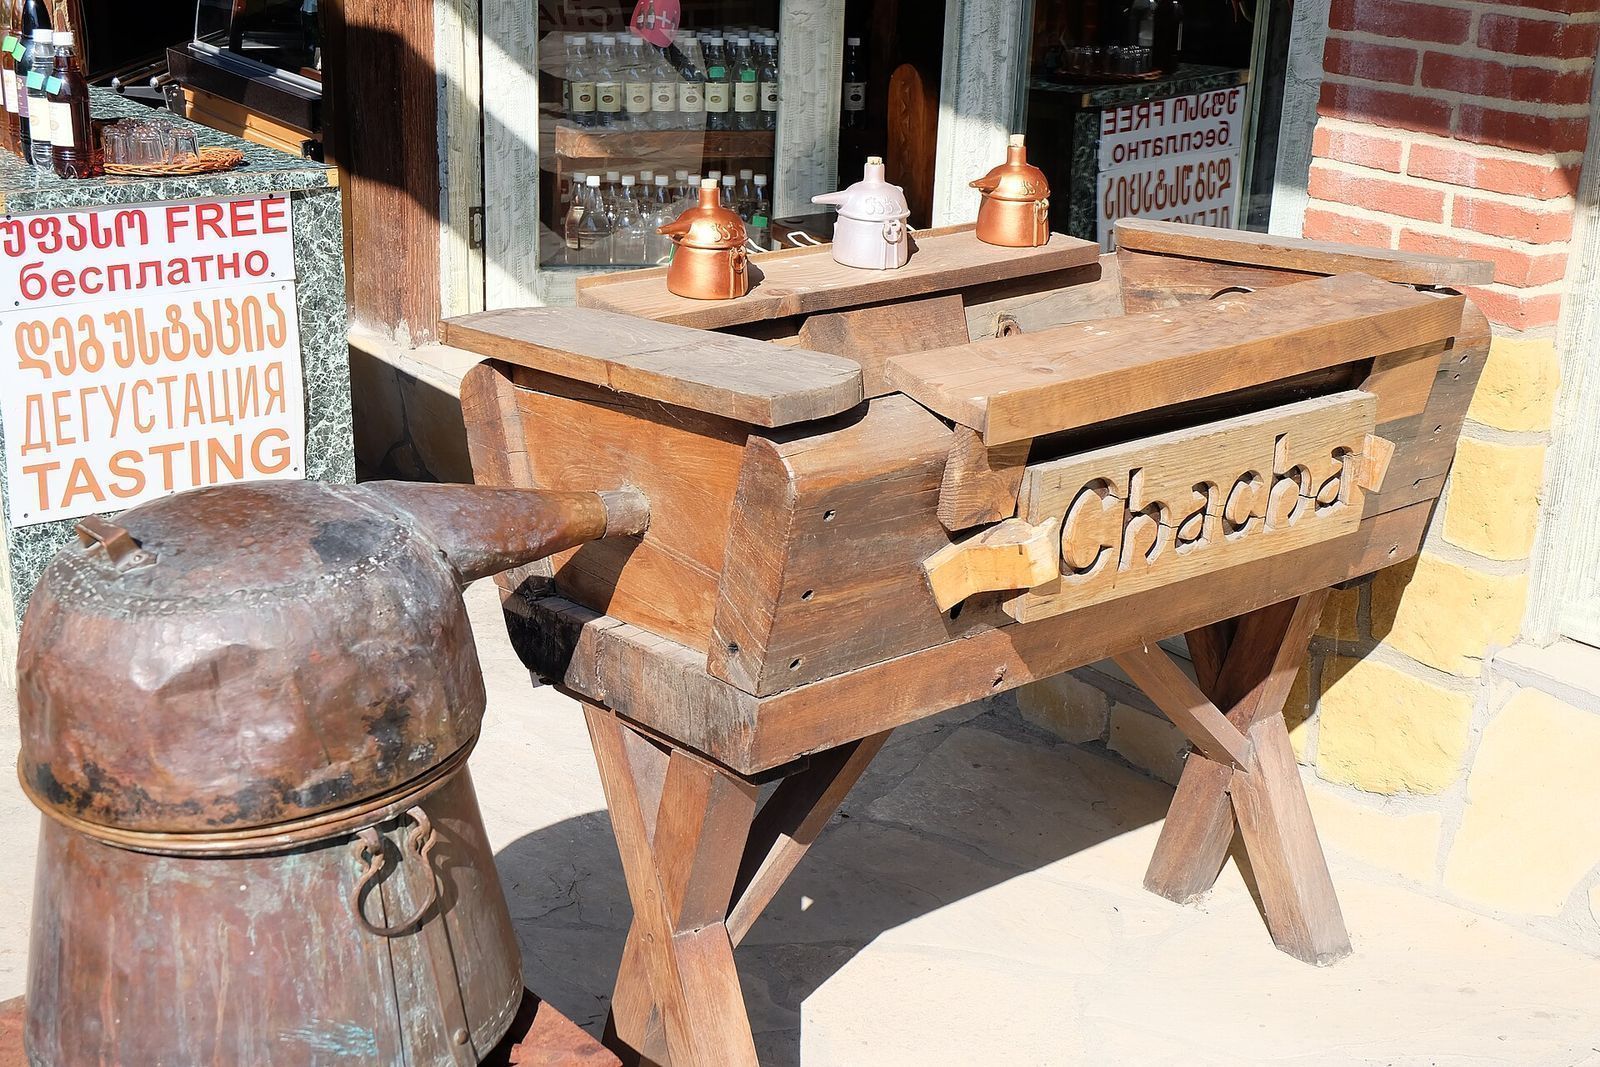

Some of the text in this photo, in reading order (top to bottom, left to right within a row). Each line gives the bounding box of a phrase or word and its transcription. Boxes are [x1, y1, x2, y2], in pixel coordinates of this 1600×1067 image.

[0, 197, 288, 257] უფასო FREE
[19, 249, 269, 300] бесплатно
[15, 292, 287, 379] დეგუსტაცია
[21, 361, 286, 456] ДЕГУСТАЦИЯ
[22, 428, 291, 511] TASTING
[1060, 432, 1358, 584] Chacha
